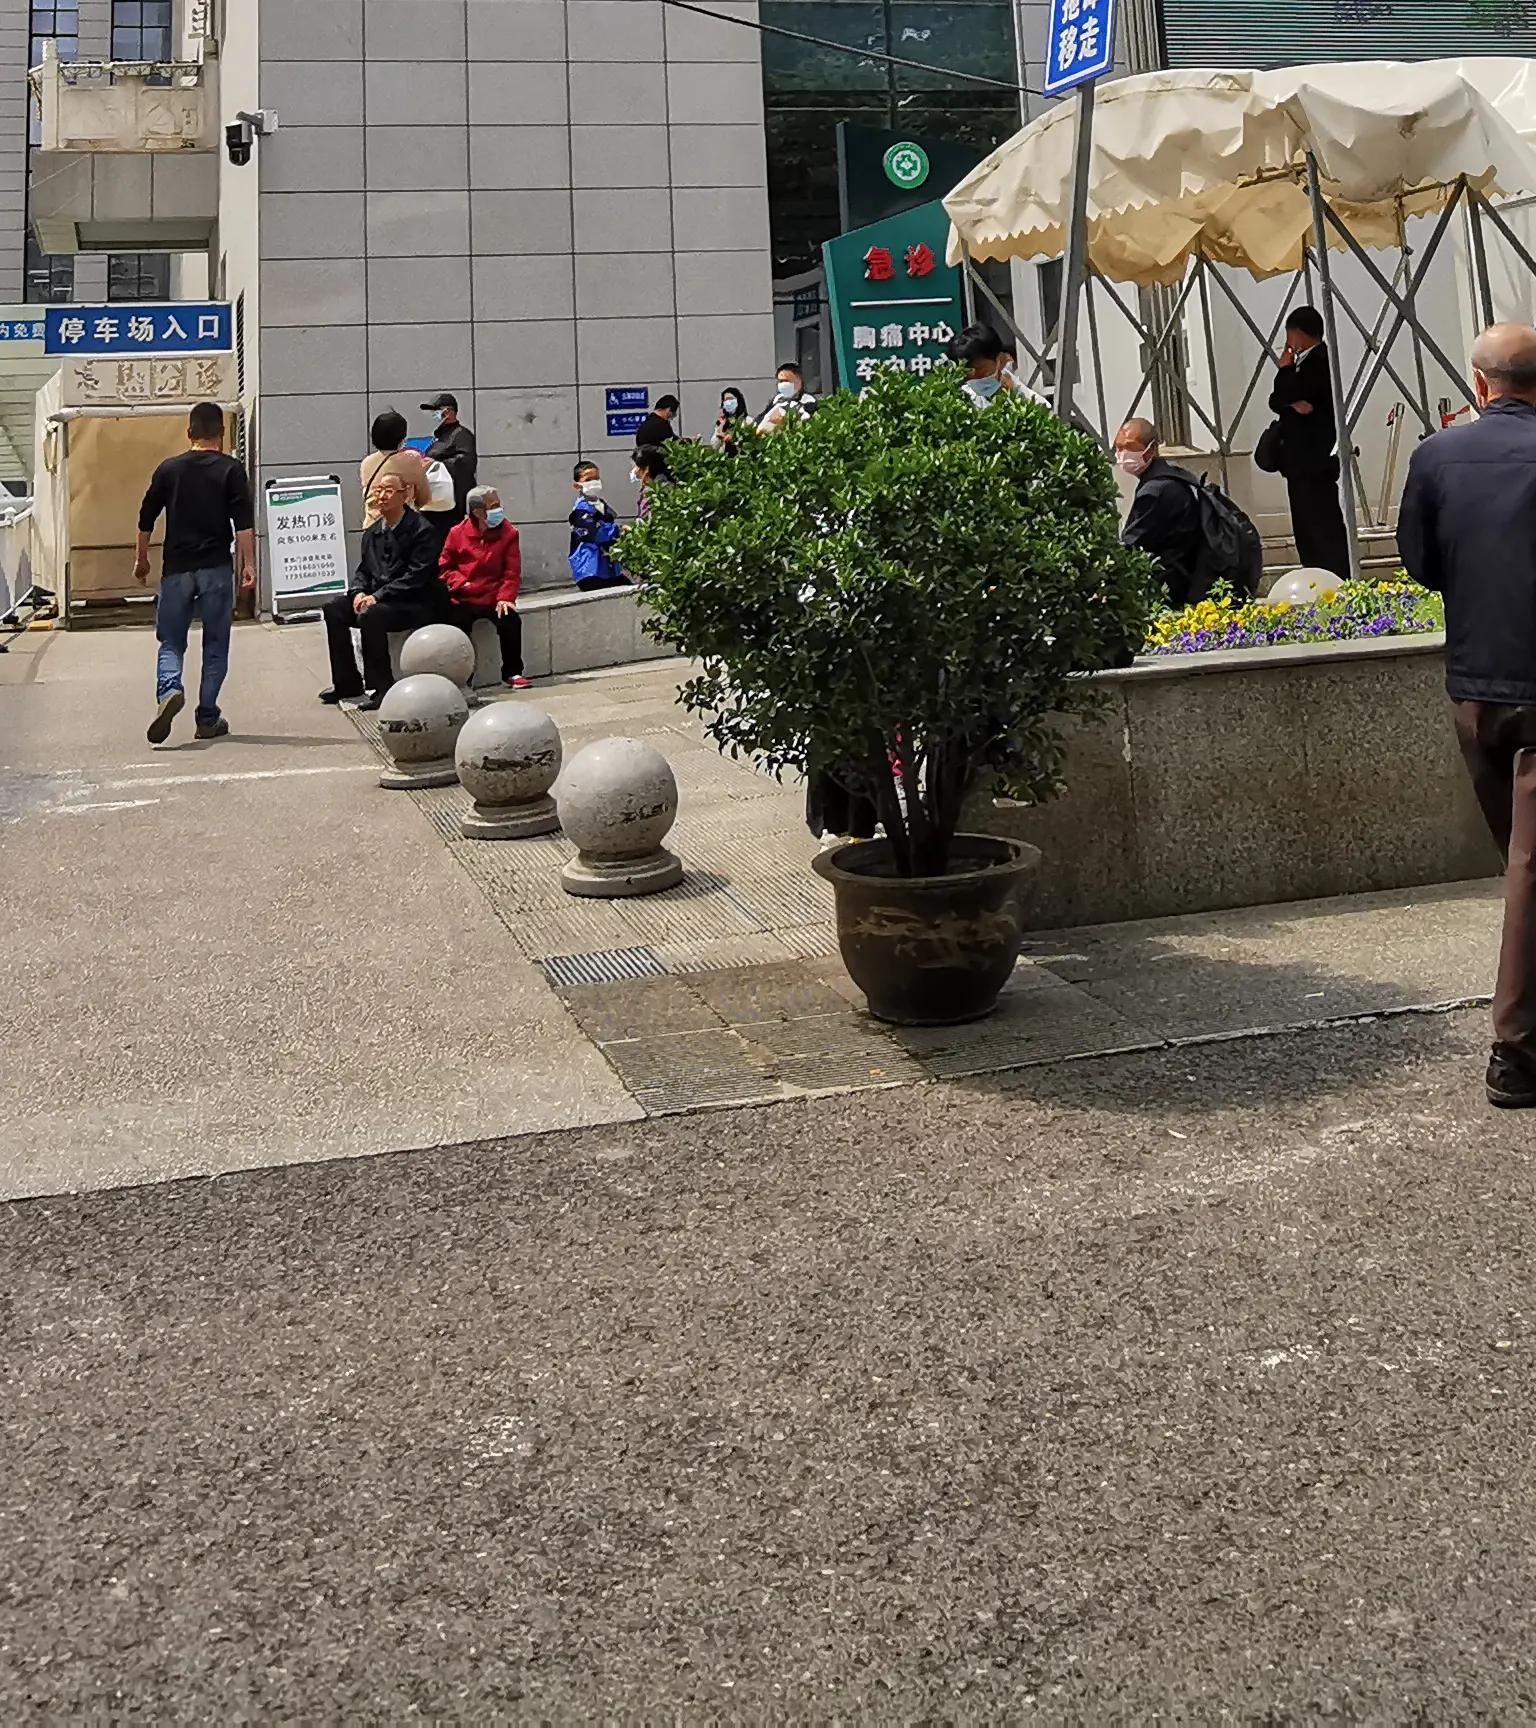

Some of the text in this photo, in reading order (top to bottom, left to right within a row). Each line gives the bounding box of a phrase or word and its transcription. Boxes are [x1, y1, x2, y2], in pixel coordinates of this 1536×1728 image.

[863, 242, 937, 281] 急诊
[57, 314, 221, 345] 停车场入口
[276, 511, 336, 532] 发热门诊
